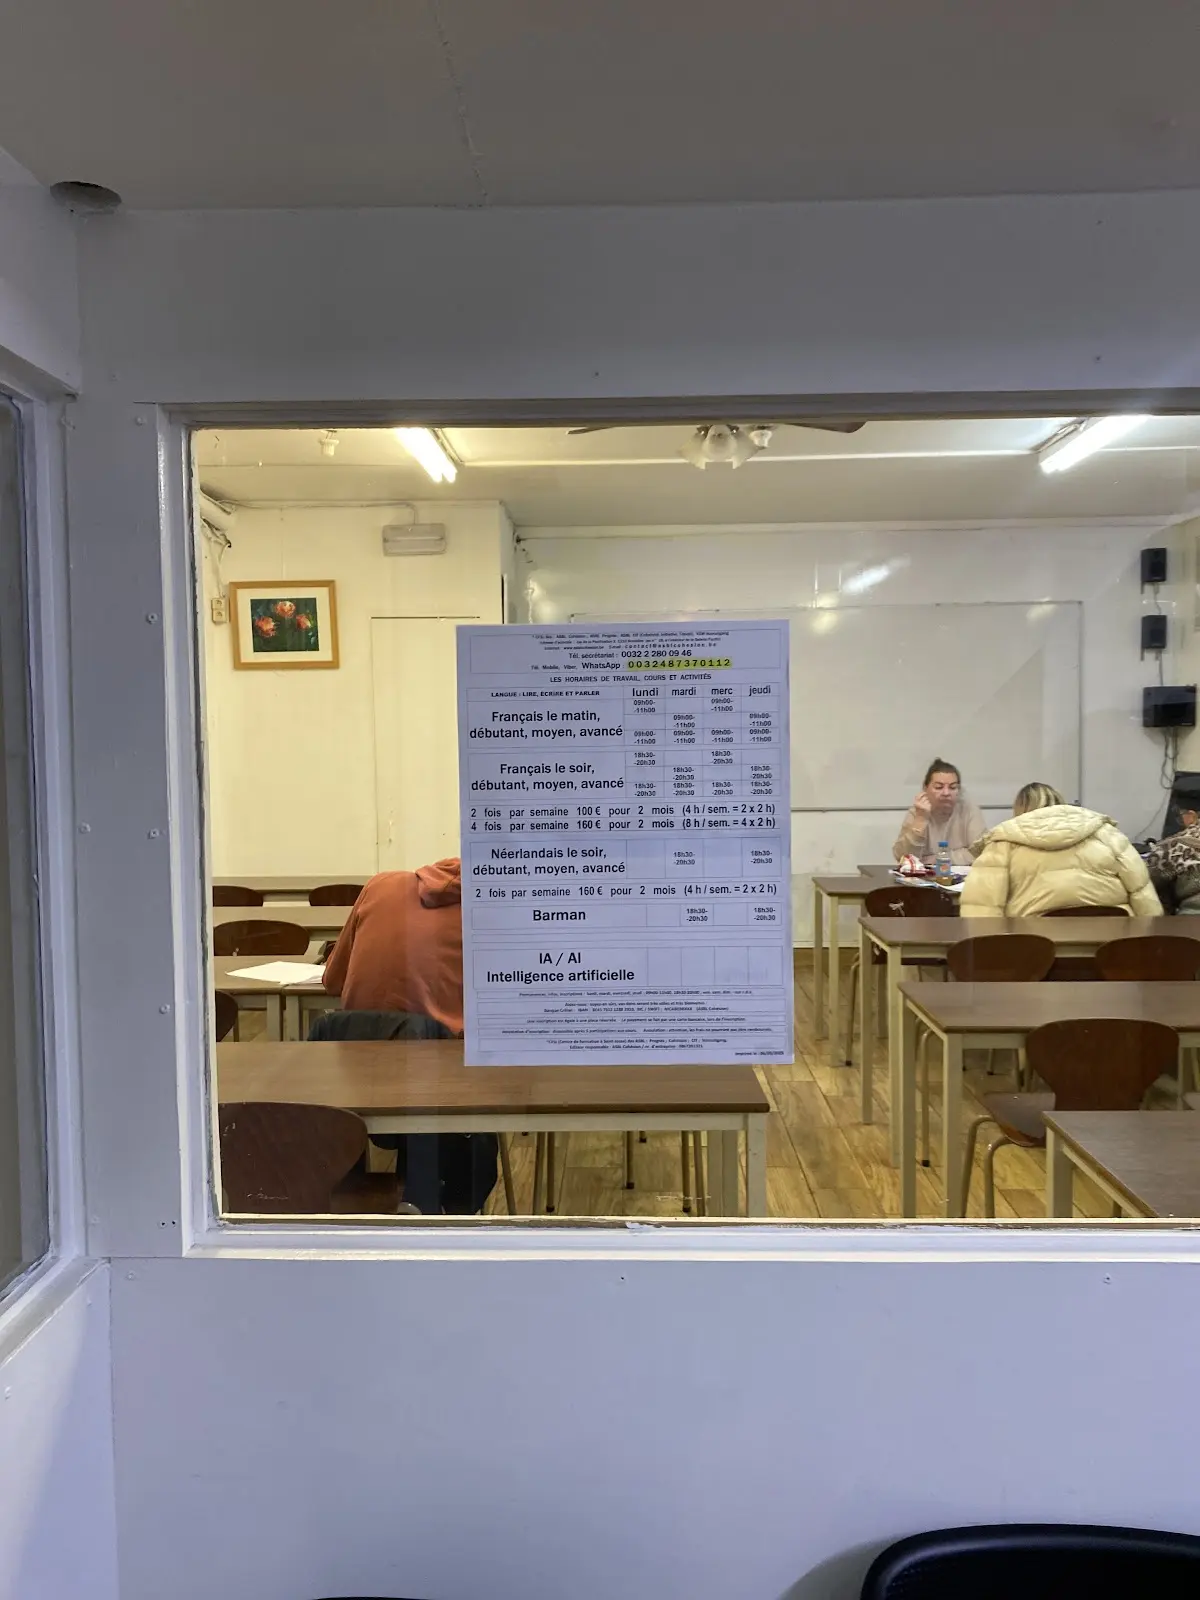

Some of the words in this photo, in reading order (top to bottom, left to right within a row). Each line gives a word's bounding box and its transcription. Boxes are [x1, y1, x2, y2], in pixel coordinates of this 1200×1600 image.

[582, 662, 620, 670] WhatsApp
[632, 688, 659, 697] lundi
[671, 687, 697, 696] mardi
[711, 687, 733, 695] merc
[749, 685, 771, 696] jeudi
[492, 711, 543, 724] Français
[547, 711, 558, 721] le
[561, 710, 600, 722] matin,
[469, 727, 528, 740] débutant,
[531, 728, 576, 740] moyen,
[580, 724, 623, 737] avancé
[500, 763, 551, 776] Français
[555, 763, 566, 773] le
[569, 763, 595, 774] soir,
[471, 780, 529, 791] débutant,
[533, 780, 577, 791] moyen,
[581, 777, 624, 789] avancé
[471, 808, 477, 818] 2
[484, 807, 501, 817] fois
[509, 809, 525, 820] par
[530, 807, 569, 817] semaine
[576, 806, 593, 816] 100
[595, 806, 601, 815] €
[608, 806, 631, 817] pour
[638, 805, 644, 815] 2
[652, 805, 674, 815] mois
[682, 804, 691, 816] (4
[694, 804, 700, 814] h
[708, 806, 730, 814] sem.
[741, 804, 747, 813] 2
[757, 804, 763, 813] 2
[766, 803, 775, 815] h)
[471, 822, 477, 831] 4
[484, 821, 502, 831] fois
[510, 822, 525, 832] par
[530, 821, 569, 830] semaine
[577, 820, 593, 829] 160
[595, 820, 601, 829] €
[609, 820, 631, 831] pour
[638, 819, 644, 828] 2
[652, 819, 674, 828] mois
[682, 818, 691, 830] (8
[694, 818, 700, 827] h
[741, 818, 747, 827] 4
[758, 817, 763, 827] 2
[766, 817, 776, 829] h)
[491, 848, 563, 859] Néerlandais
[567, 847, 578, 858] le
[581, 847, 607, 858] soir,
[473, 864, 531, 876] débutant,
[534, 865, 579, 876] moyen,
[582, 862, 625, 873] avancé
[475, 888, 481, 898] 2
[489, 888, 506, 897] fois
[511, 889, 527, 900] par
[532, 886, 571, 897] semaine
[578, 886, 595, 896] 160
[597, 886, 603, 896] €
[610, 887, 632, 897] pour
[640, 885, 646, 895] 2
[653, 885, 676, 895] mois
[684, 884, 693, 896] (4
[695, 884, 701, 894] h
[709, 886, 732, 894] sem.
[742, 884, 748, 893] 2
[759, 884, 765, 893] 2
[767, 883, 777, 895] h)
[533, 910, 586, 921] Barman
[539, 952, 553, 964] IA
[555, 952, 564, 966] /
[567, 952, 581, 964] AI
[487, 970, 564, 984] Intelligence
[568, 969, 635, 981] artificielle
